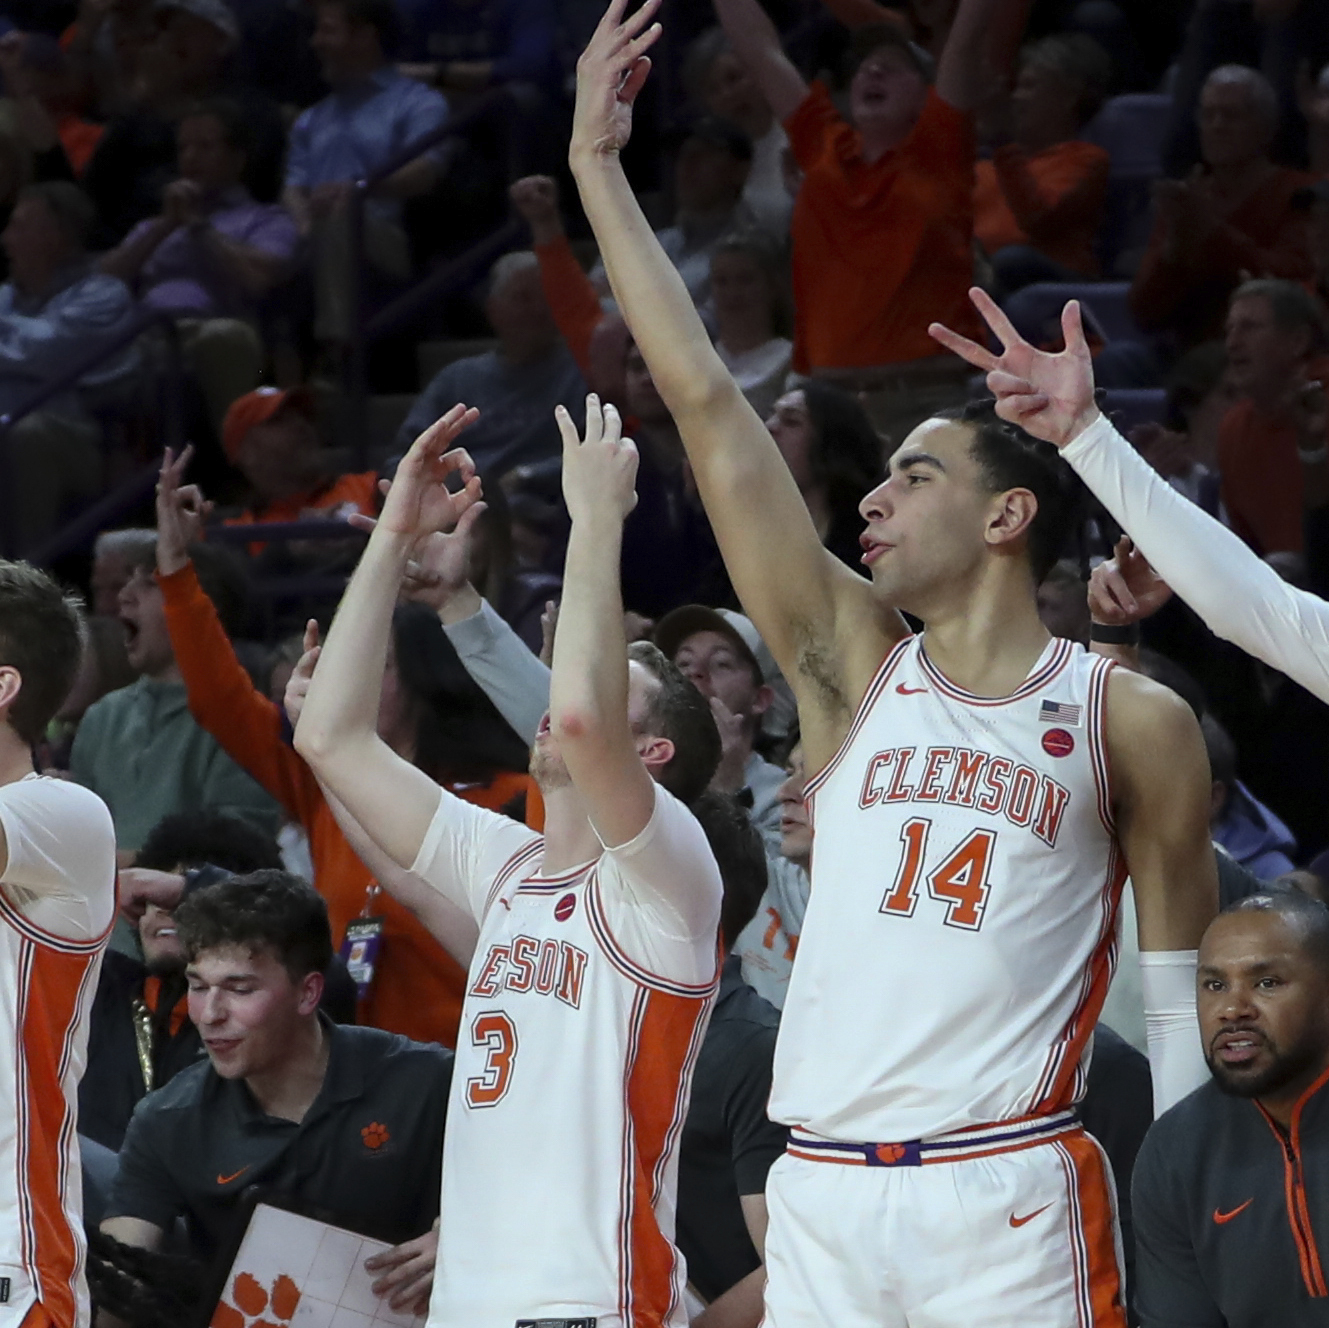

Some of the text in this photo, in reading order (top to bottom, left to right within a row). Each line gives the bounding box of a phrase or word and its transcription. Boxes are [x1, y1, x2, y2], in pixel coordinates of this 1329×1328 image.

[858, 746, 1071, 849] CLEMSON
[878, 816, 998, 931] 14
[465, 1010, 518, 1109] 3
